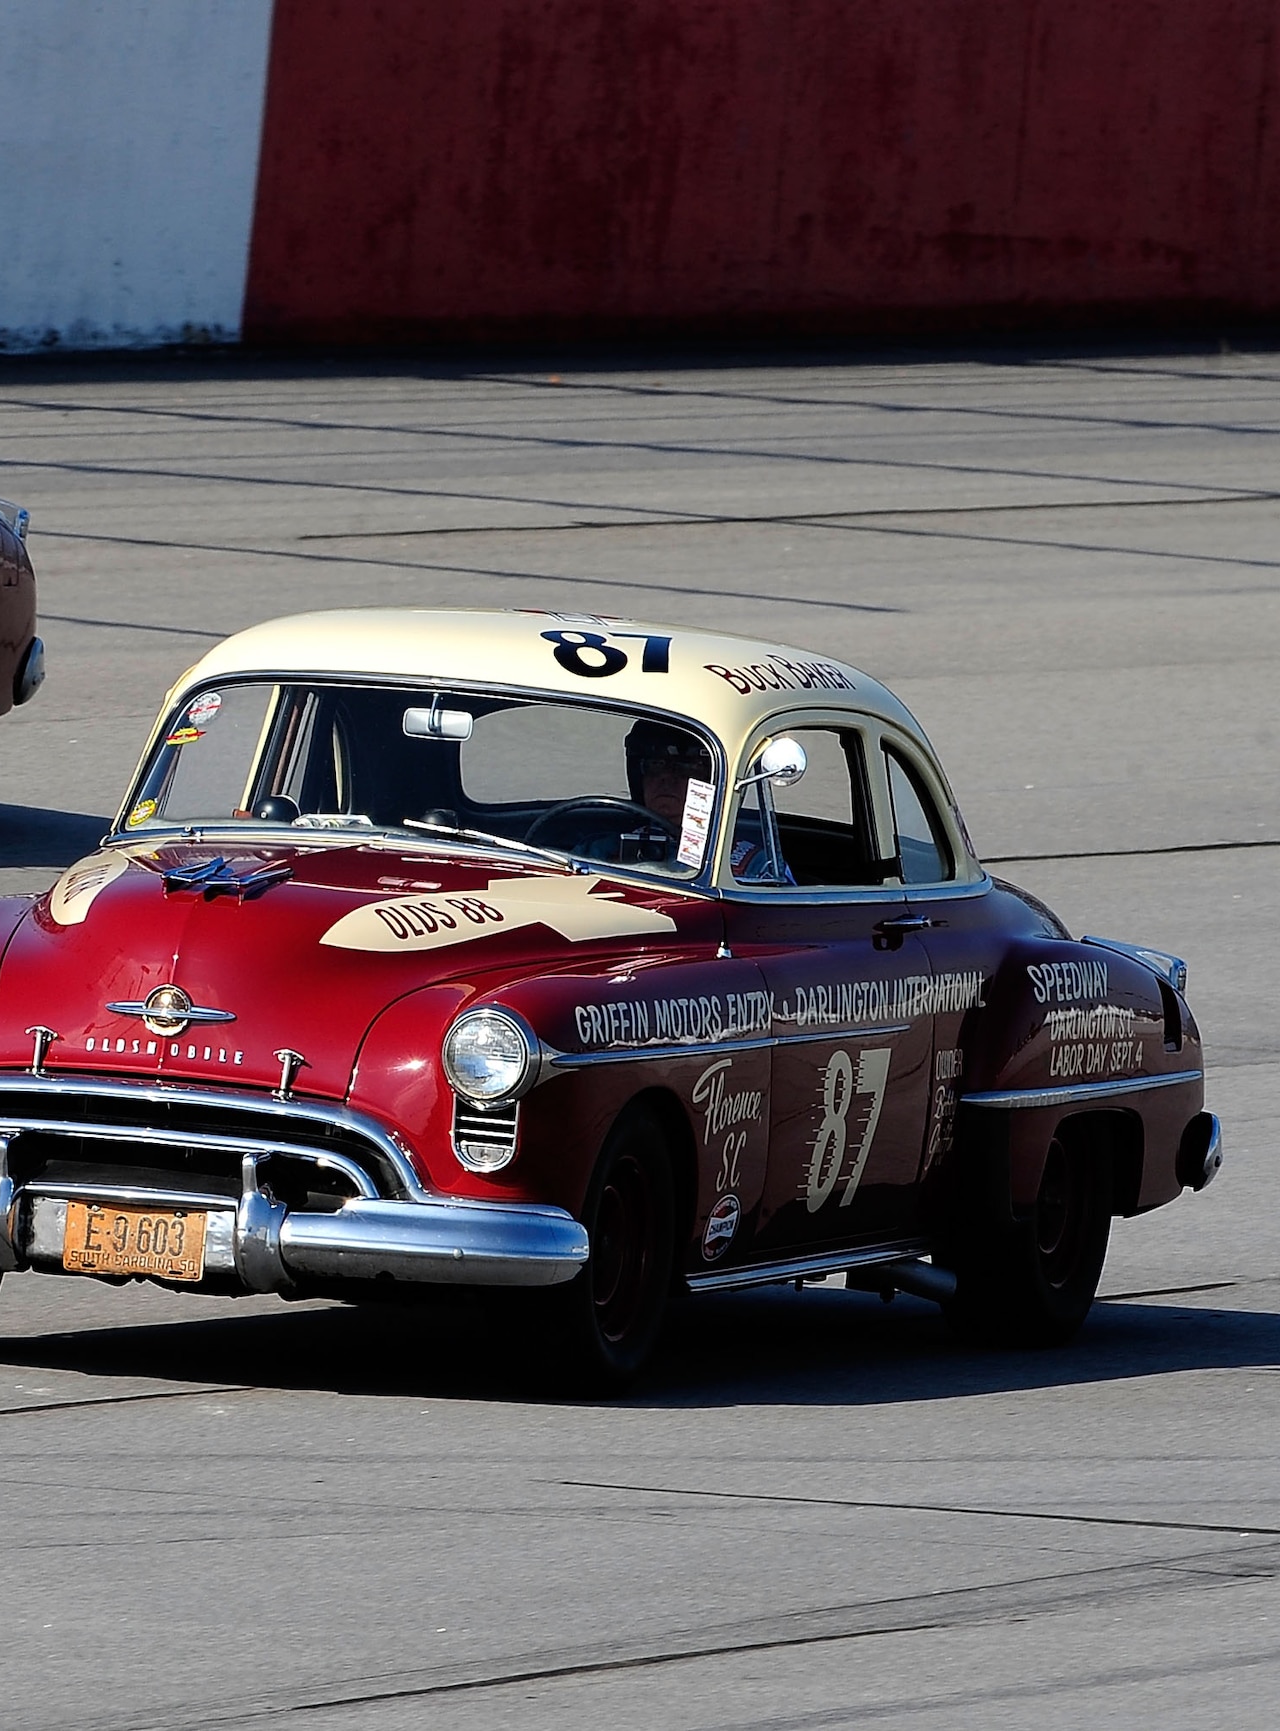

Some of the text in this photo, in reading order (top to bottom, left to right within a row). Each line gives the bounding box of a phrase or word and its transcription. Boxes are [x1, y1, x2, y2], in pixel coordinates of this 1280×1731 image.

[540, 630, 673, 678] 87
[765, 654, 857, 691] BAKER
[374, 897, 505, 940] OLDS 88
[1026, 961, 1109, 1004] SPEEDWAY
[574, 1001, 650, 1045] GRIFFIN
[652, 995, 722, 1043] MOTORS
[725, 990, 776, 1034] ENTRY
[794, 979, 890, 1027] DARLINGTON
[891, 970, 988, 1019] INTERNATIONAL
[85, 1037, 245, 1065] OLDSMOBILE
[1050, 1043, 1084, 1077] LABOR
[1135, 1040, 1144, 1069] 4
[800, 1047, 892, 1214] 87
[70, 1250, 196, 1273] SOUTH CAROLINA 50
